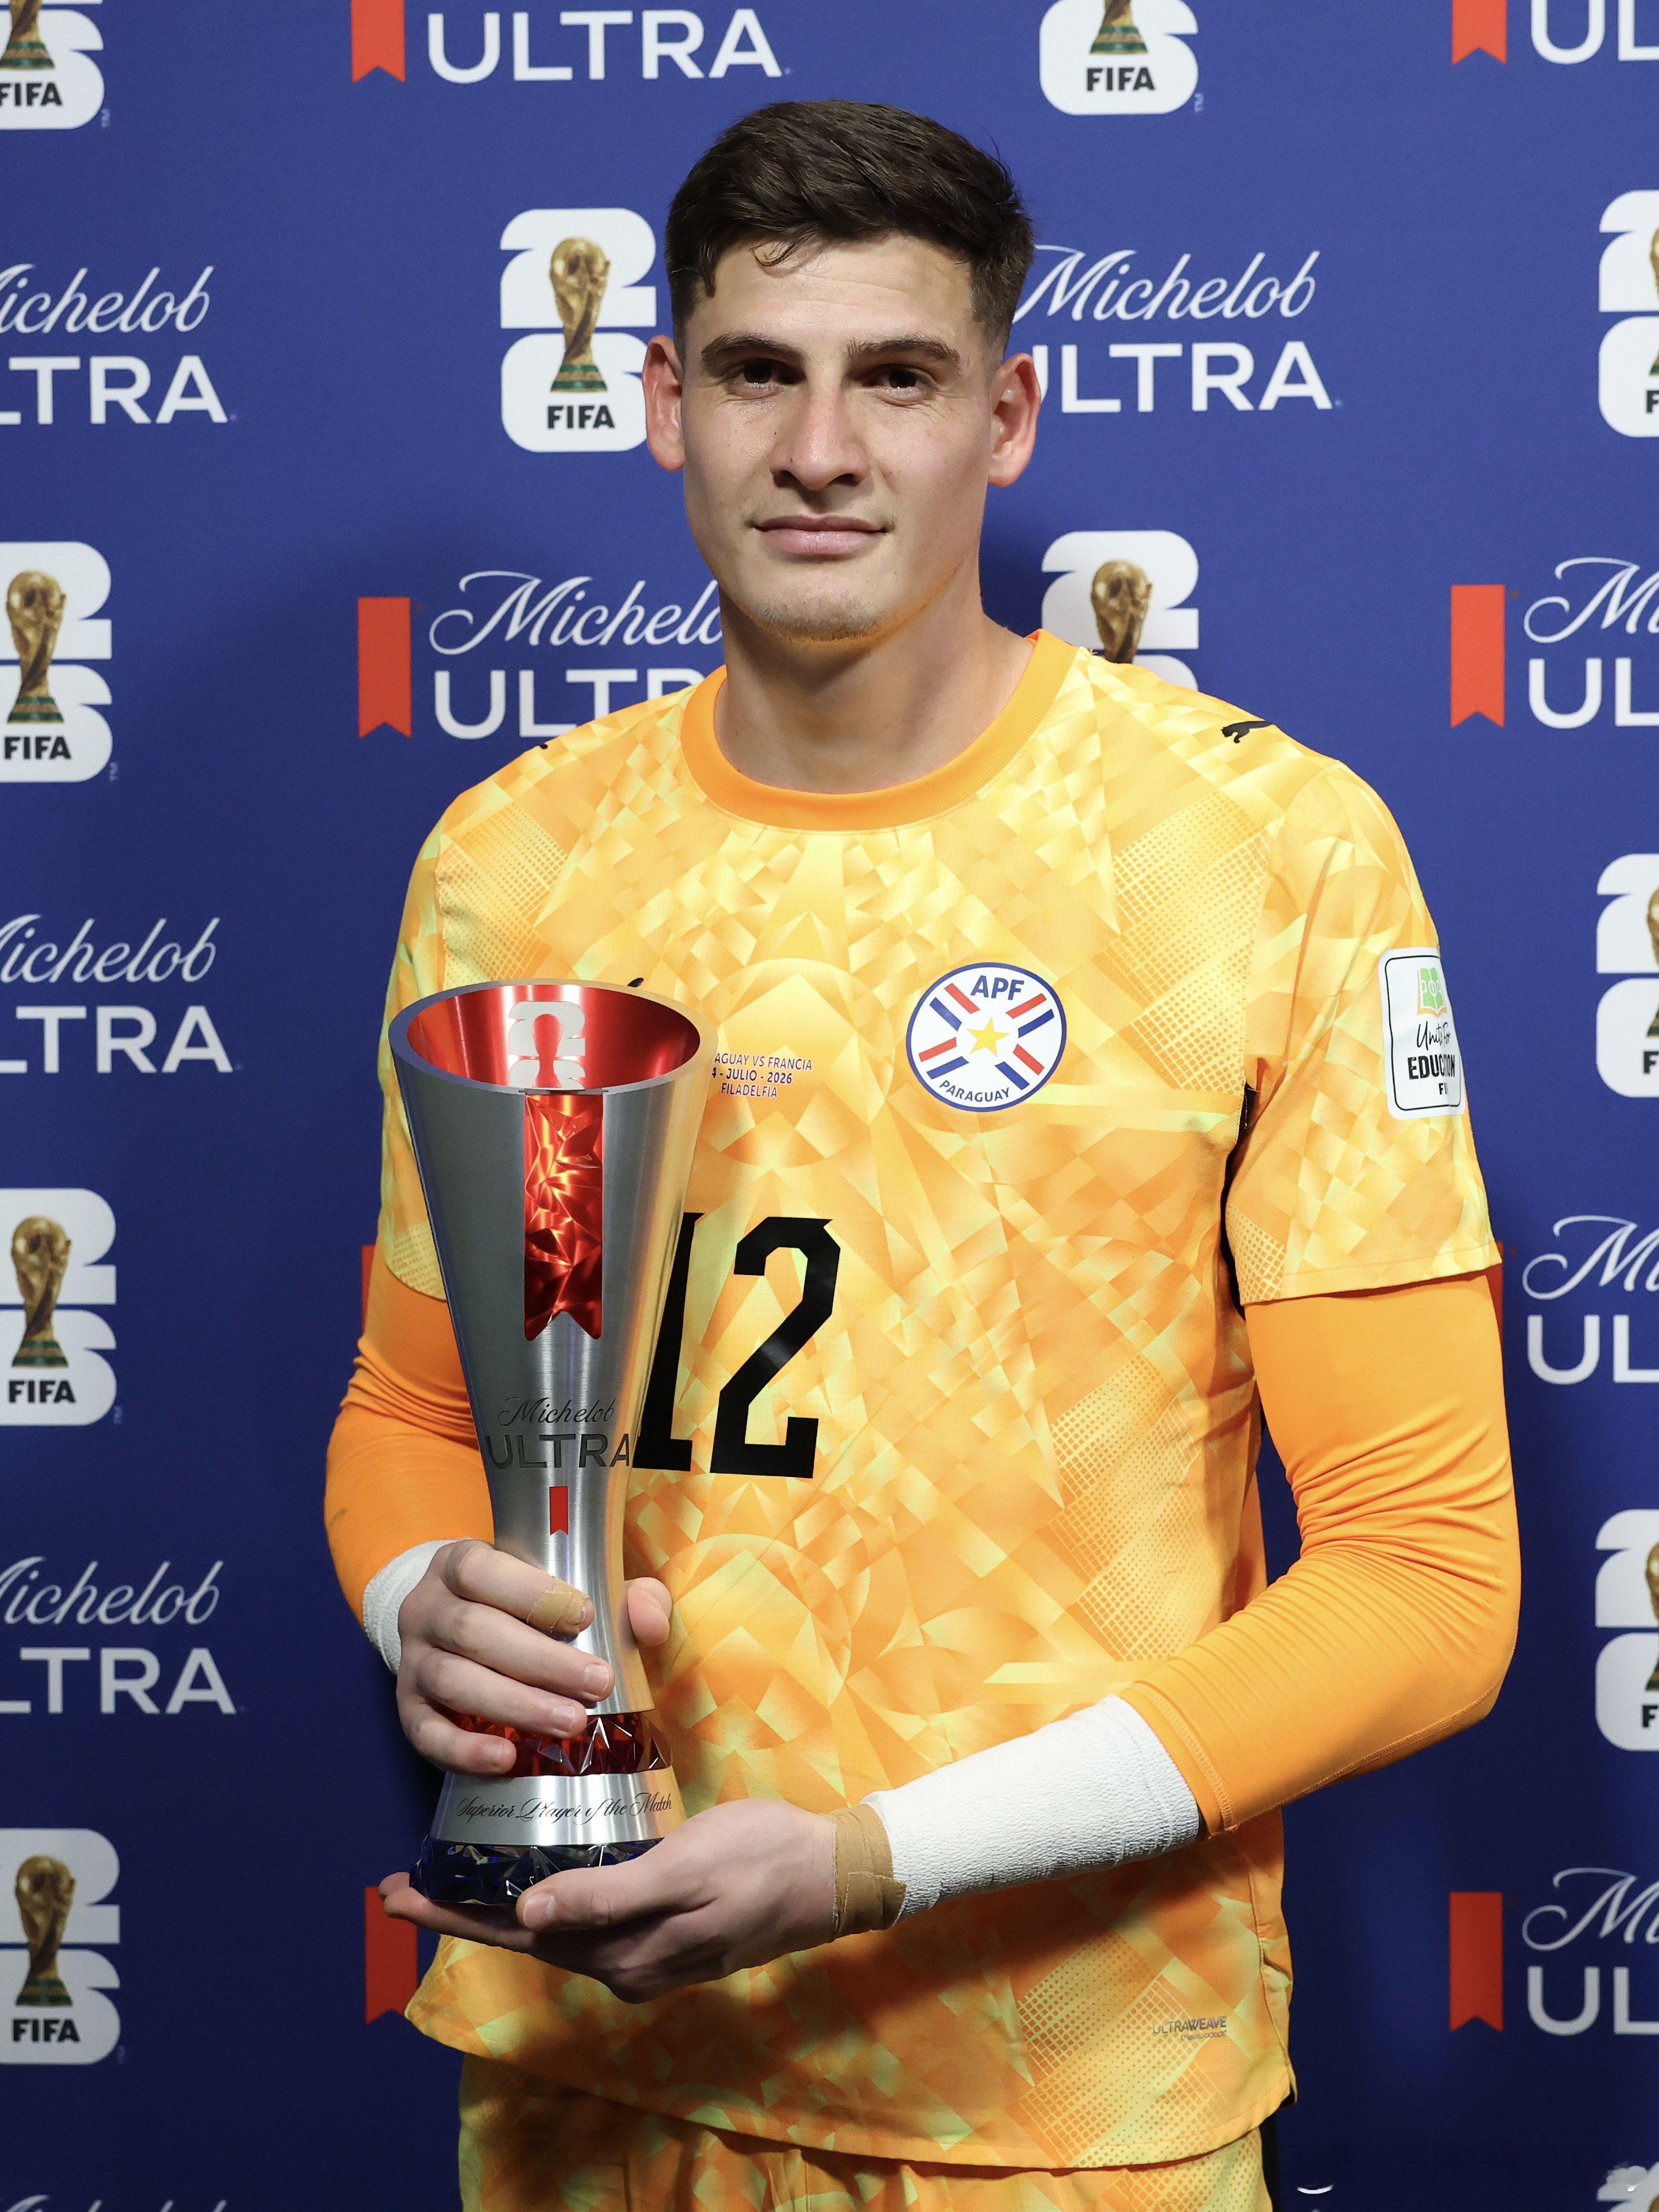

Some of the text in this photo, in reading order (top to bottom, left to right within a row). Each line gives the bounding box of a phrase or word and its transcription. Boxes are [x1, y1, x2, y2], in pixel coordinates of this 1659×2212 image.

[428, 9, 782, 83] ULTRA
[1086, 67, 1156, 92] FIFA
[0, 82, 63, 107] FIFA
[1012, 245, 1320, 321] Michelob
[0, 263, 214, 334] ichelob
[547, 405, 615, 430] FIFA
[4, 736, 72, 760] FIFA
[0, 914, 220, 983] ichelob
[970, 975, 1024, 1000] APF
[753, 1055, 766, 1067] VS
[768, 1056, 812, 1070] FRANCIA
[726, 1068, 757, 1081] JULIO
[767, 1071, 792, 1084] 2026
[721, 1082, 778, 1098] FILADELFIA
[939, 1079, 1011, 1102] PARAGUAY
[632, 1212, 841, 1479] 12
[8, 1379, 76, 1404] FIFA
[498, 1397, 616, 1426] Michelob
[486, 1433, 630, 1470] ULTRA
[0, 1556, 224, 1625] ichelob
[456, 1796, 516, 1824] Superior
[515, 1798, 582, 1825] Player
[604, 1798, 628, 1816] the
[629, 1791, 672, 1817] Match
[12, 2018, 80, 2043] FIFA
[1152, 2016, 1227, 2034] ULTRAWEAVE
